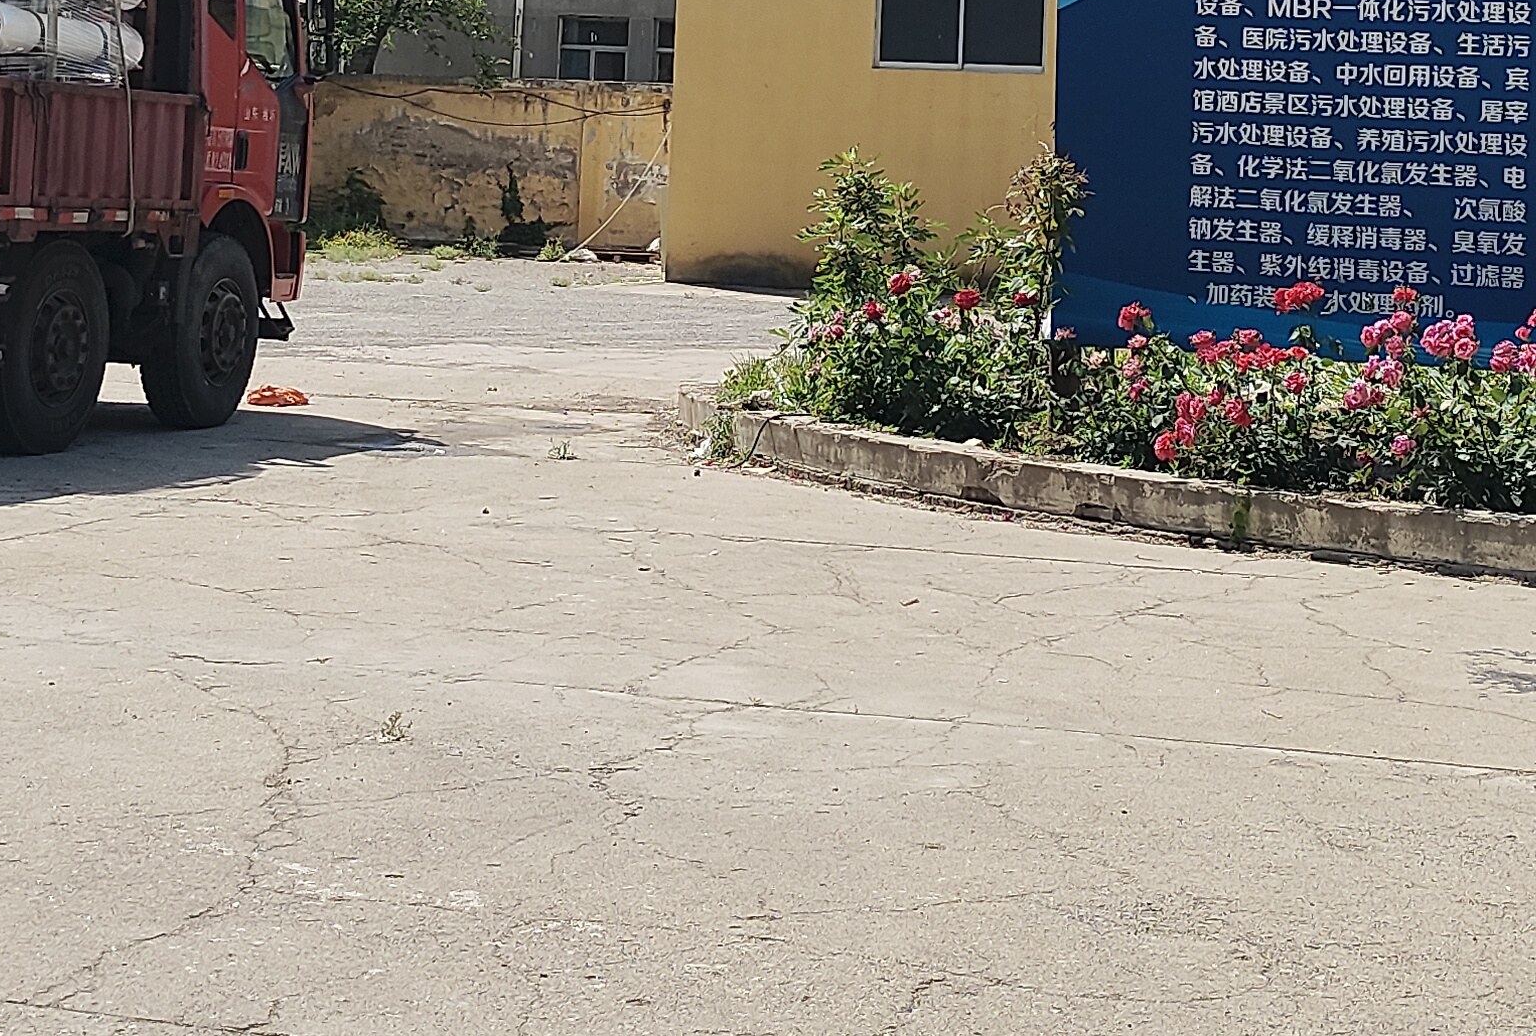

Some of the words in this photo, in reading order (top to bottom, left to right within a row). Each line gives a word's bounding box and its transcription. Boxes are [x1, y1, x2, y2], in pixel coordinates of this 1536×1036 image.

[1193, 24, 1531, 57] 备、医院污水处理设备、生活污
[1193, 56, 1530, 91] 水处理设备、中水回用设备、宾
[1192, 89, 1529, 124] 馆酒店景区污水处理设备、屠宰
[1191, 121, 1528, 158] 污水处理设备、养殖污水处理设
[1454, 197, 1527, 224] 次氯酸
